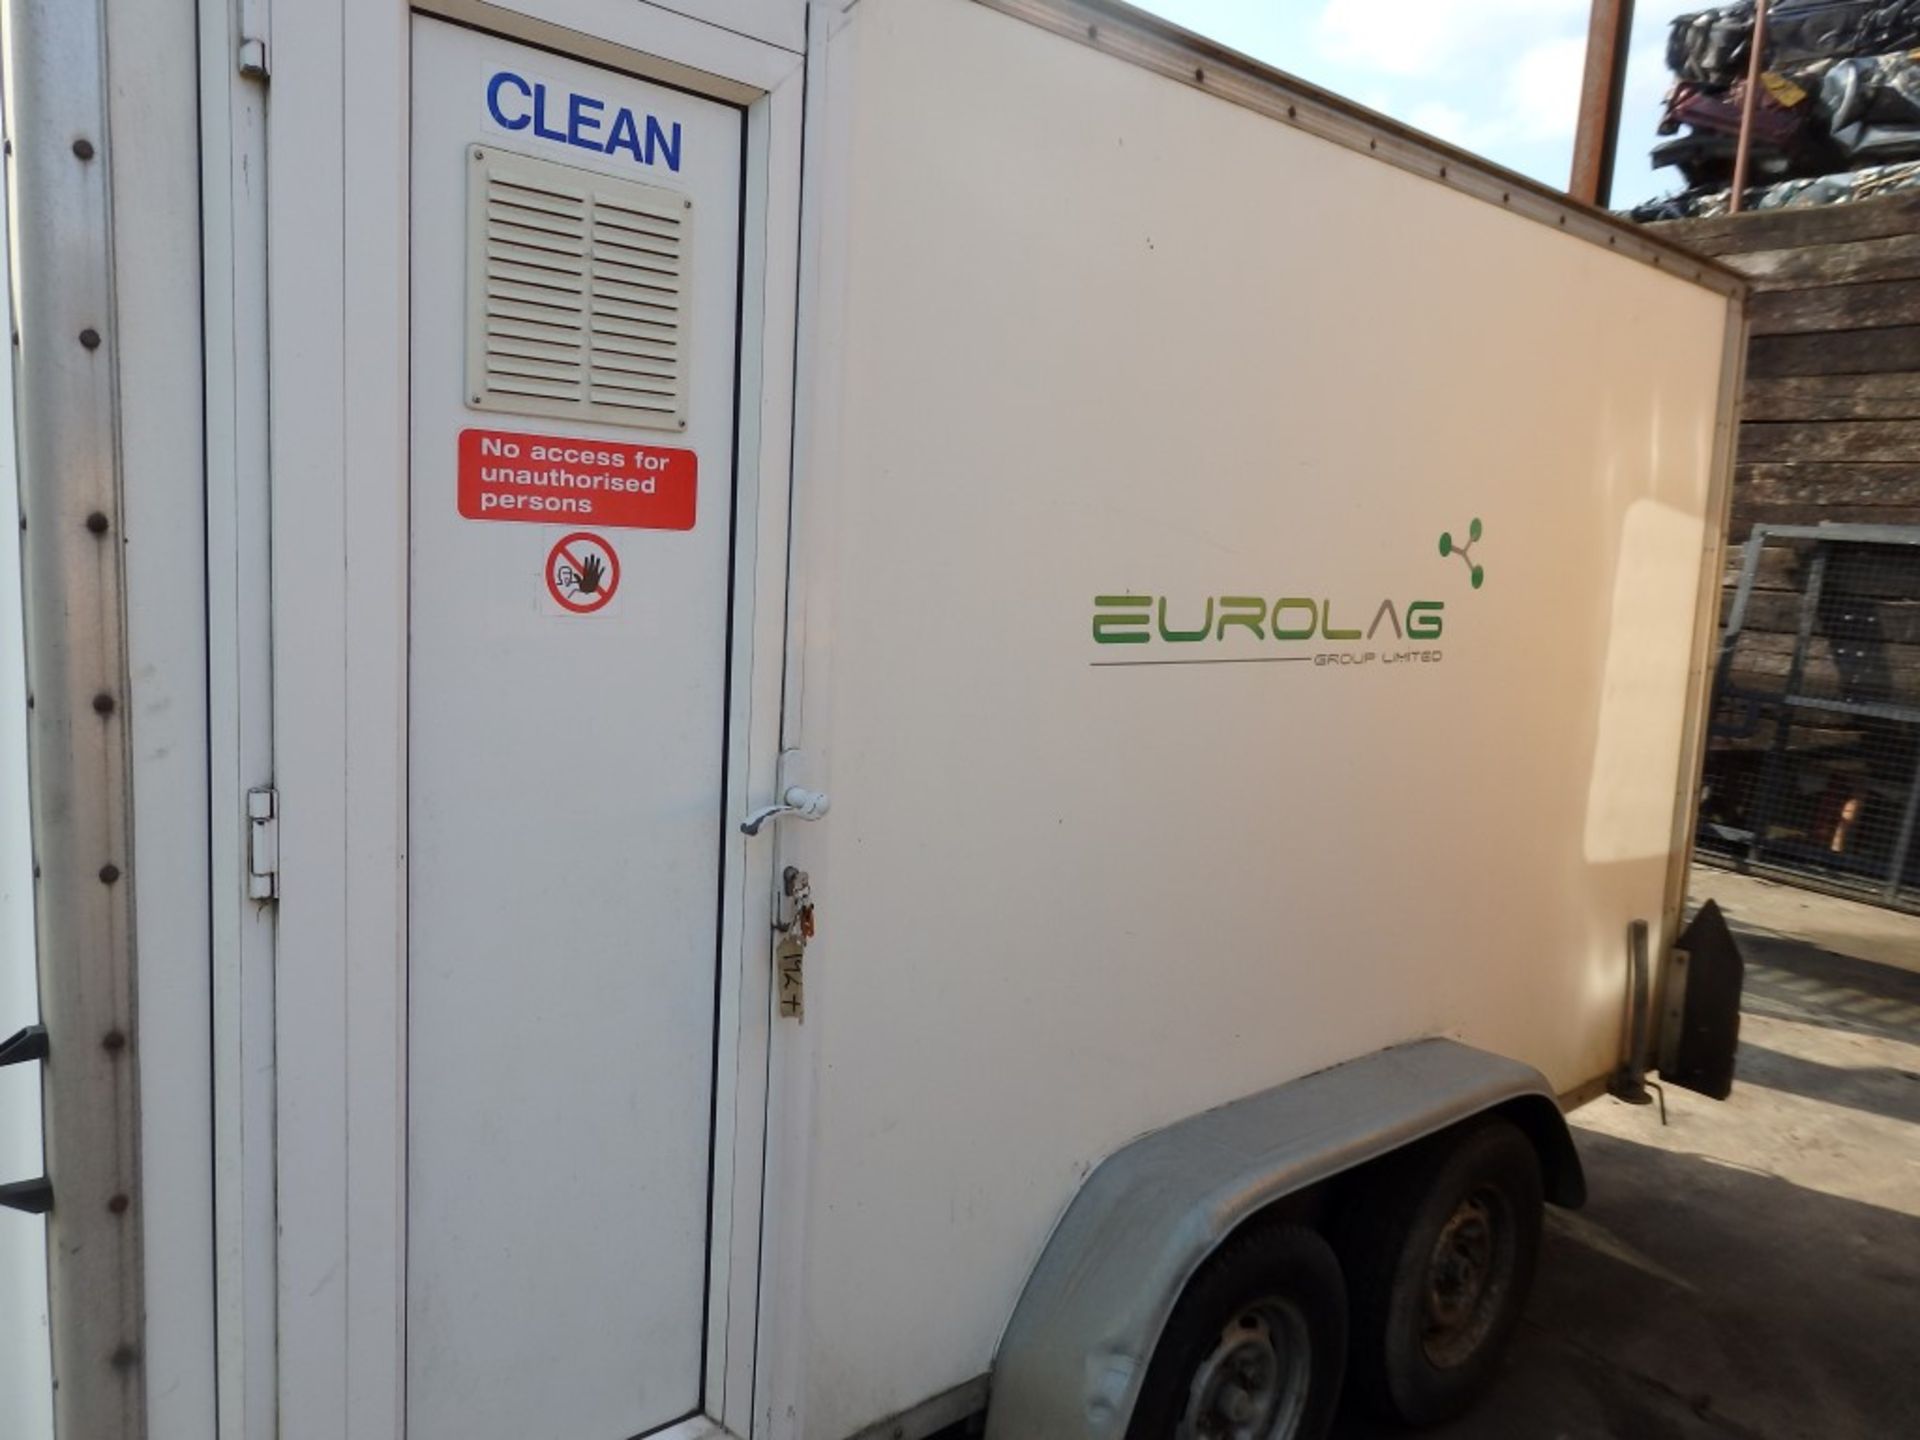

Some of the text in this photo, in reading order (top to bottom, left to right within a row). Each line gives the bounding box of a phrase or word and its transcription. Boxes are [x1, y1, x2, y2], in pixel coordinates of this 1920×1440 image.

[487, 71, 682, 172] CLEAN
[481, 437, 670, 471] No access for
[481, 466, 656, 494] unauthorised
[481, 492, 593, 514] persons
[1092, 595, 1445, 643] EUROLAG
[1313, 650, 1443, 666] GROUP LIMITED
